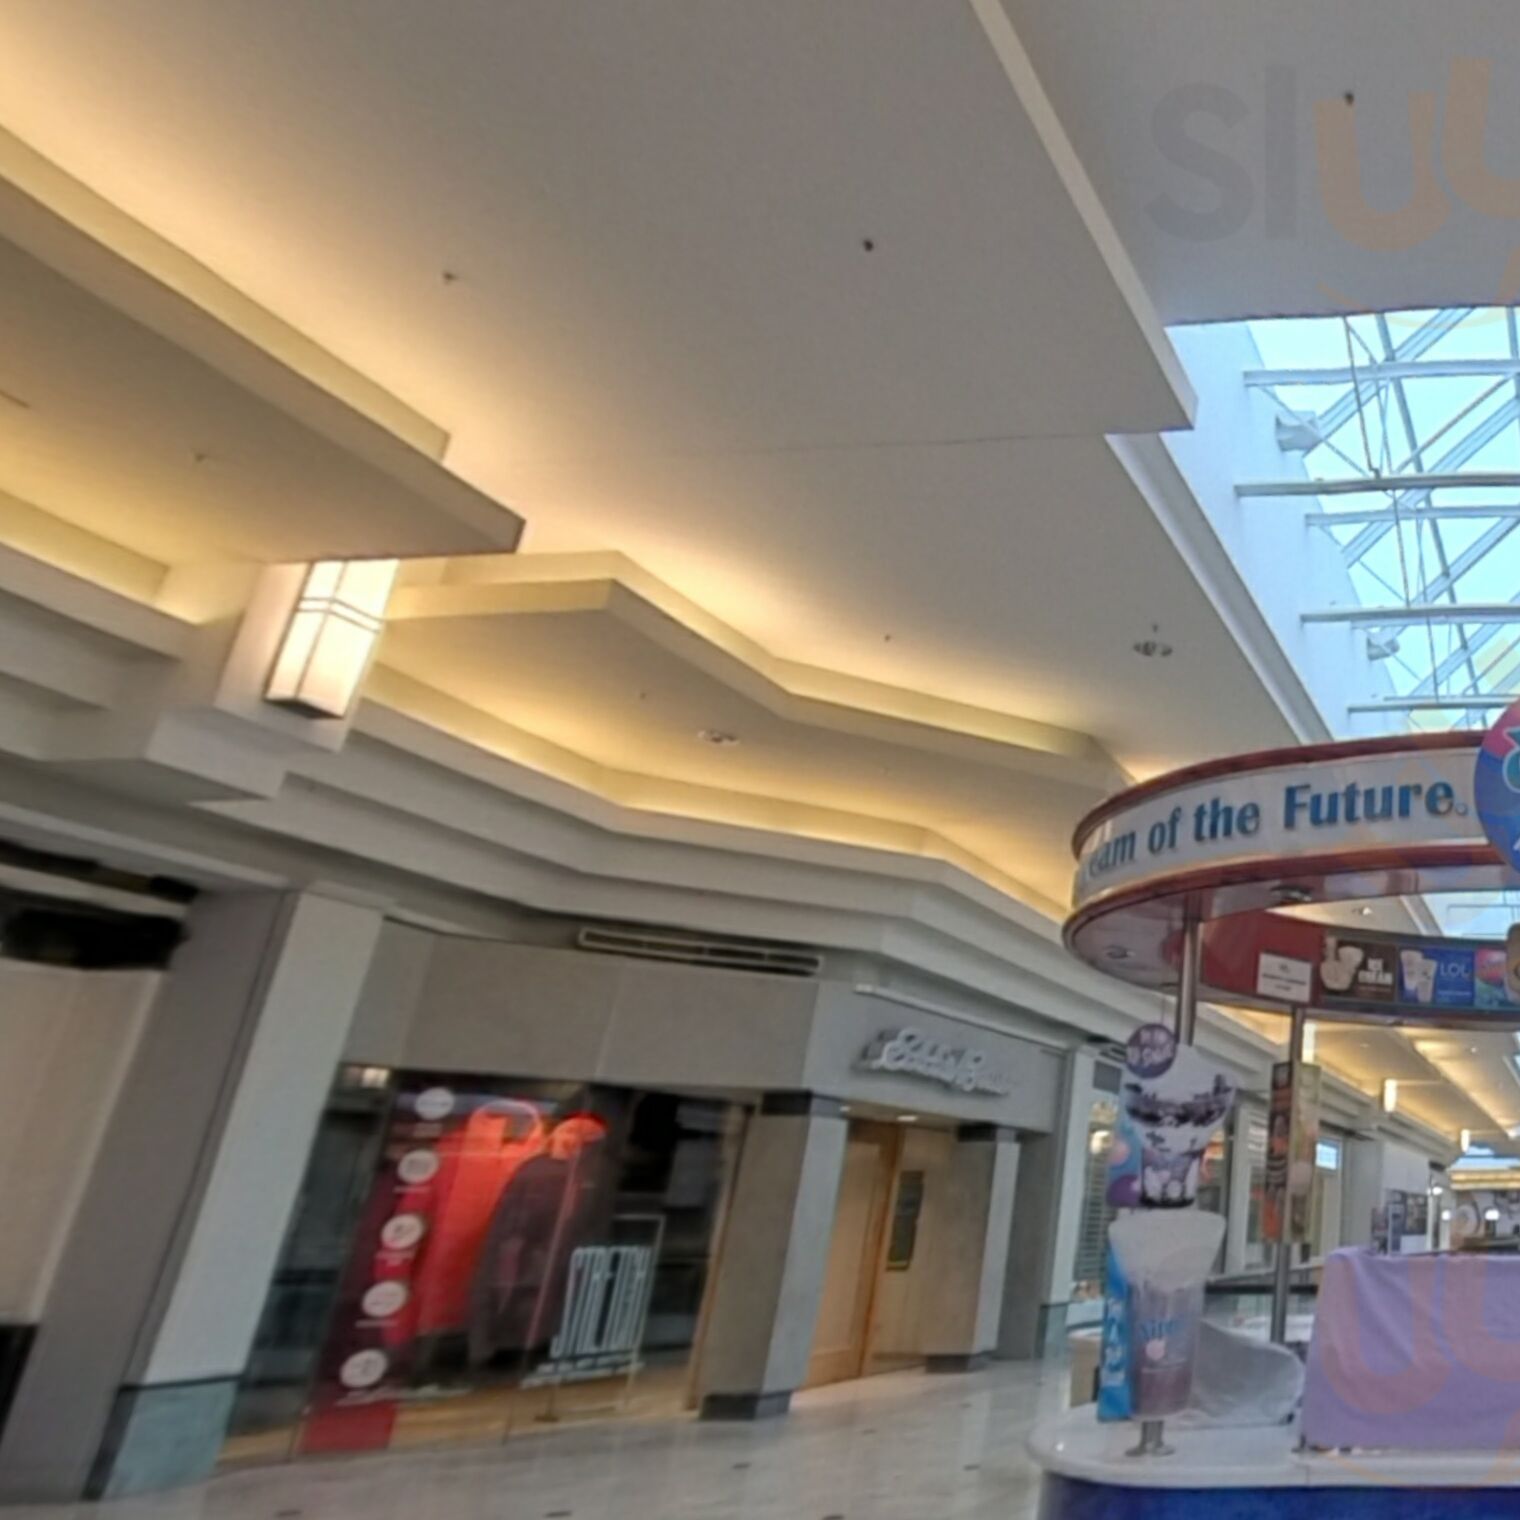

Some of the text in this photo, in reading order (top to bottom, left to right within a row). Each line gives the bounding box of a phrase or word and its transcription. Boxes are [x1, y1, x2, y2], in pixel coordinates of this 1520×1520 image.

[1088, 829, 1136, 878] eam
[1148, 806, 1182, 854] of
[1193, 797, 1260, 844] the
